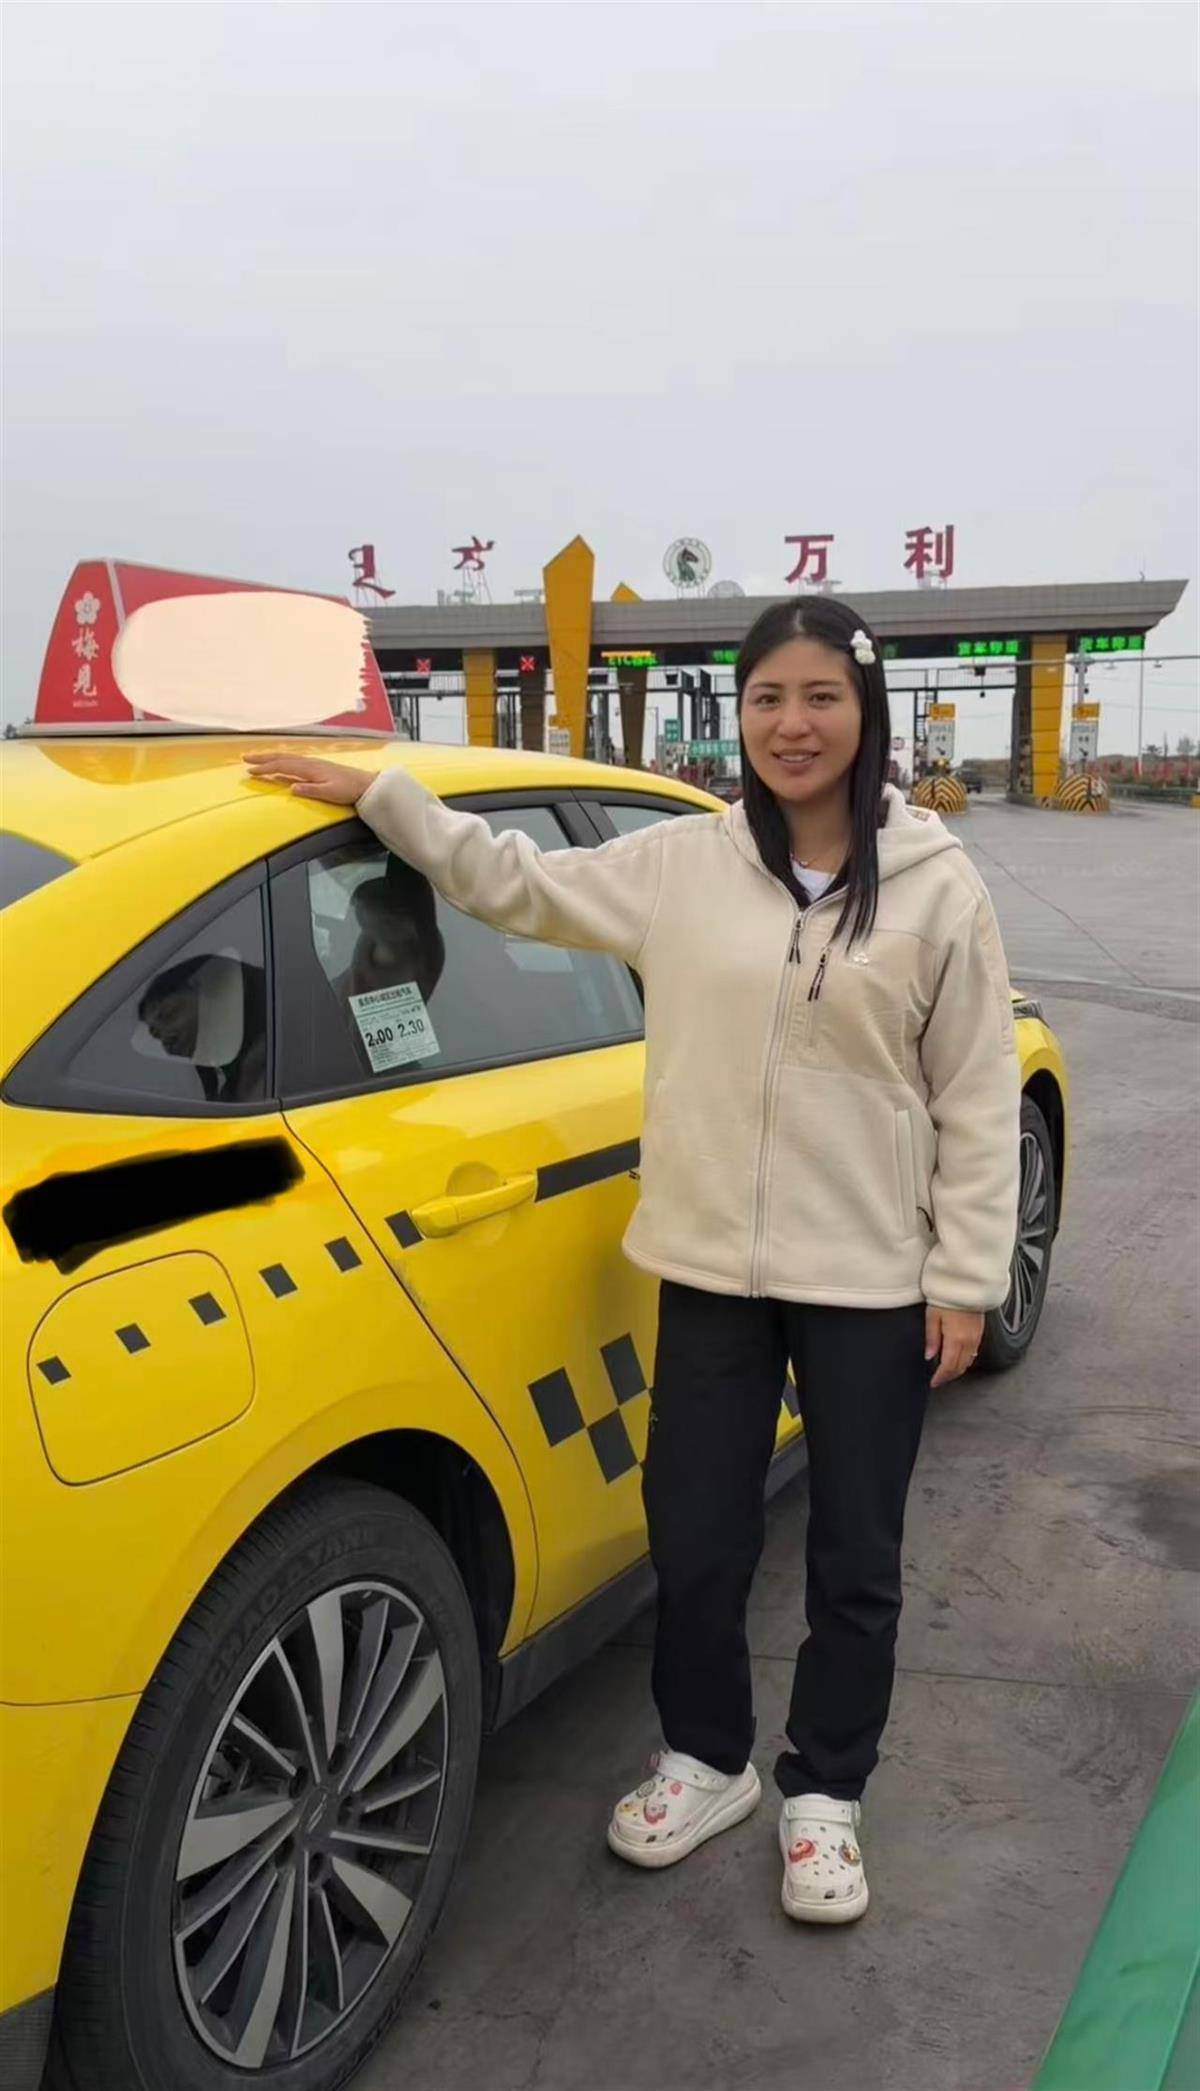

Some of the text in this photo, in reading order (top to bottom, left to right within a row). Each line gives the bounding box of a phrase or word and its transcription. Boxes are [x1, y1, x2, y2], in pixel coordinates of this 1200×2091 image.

[784, 525, 954, 583] 万利
[365, 1019, 424, 1047] 2.00 2.30
